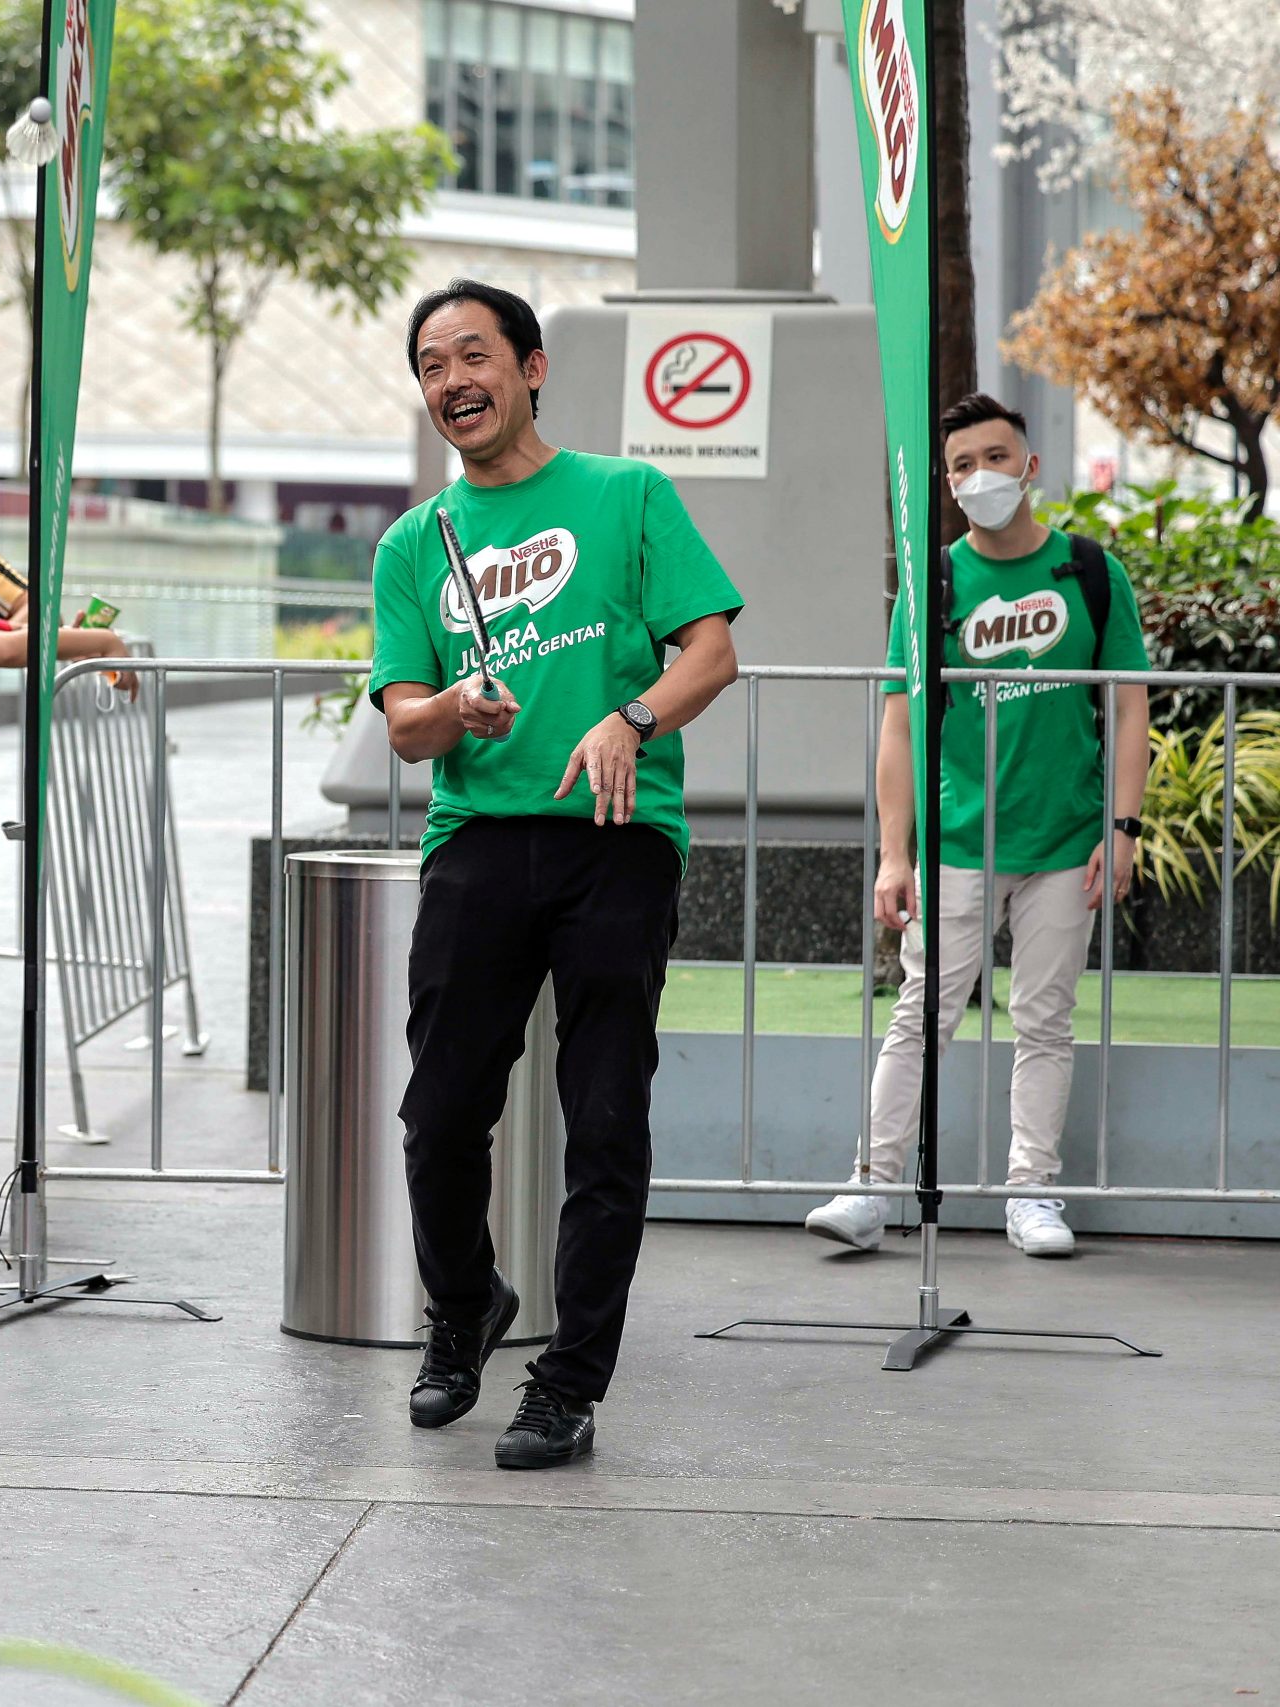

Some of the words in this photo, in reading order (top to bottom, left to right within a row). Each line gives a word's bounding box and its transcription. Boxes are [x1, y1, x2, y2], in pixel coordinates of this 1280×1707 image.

[870, 0, 907, 204] MILO
[896, 446, 922, 698] milo.com.my
[974, 610, 1058, 649] MILO
[537, 622, 606, 657] GENTAR
